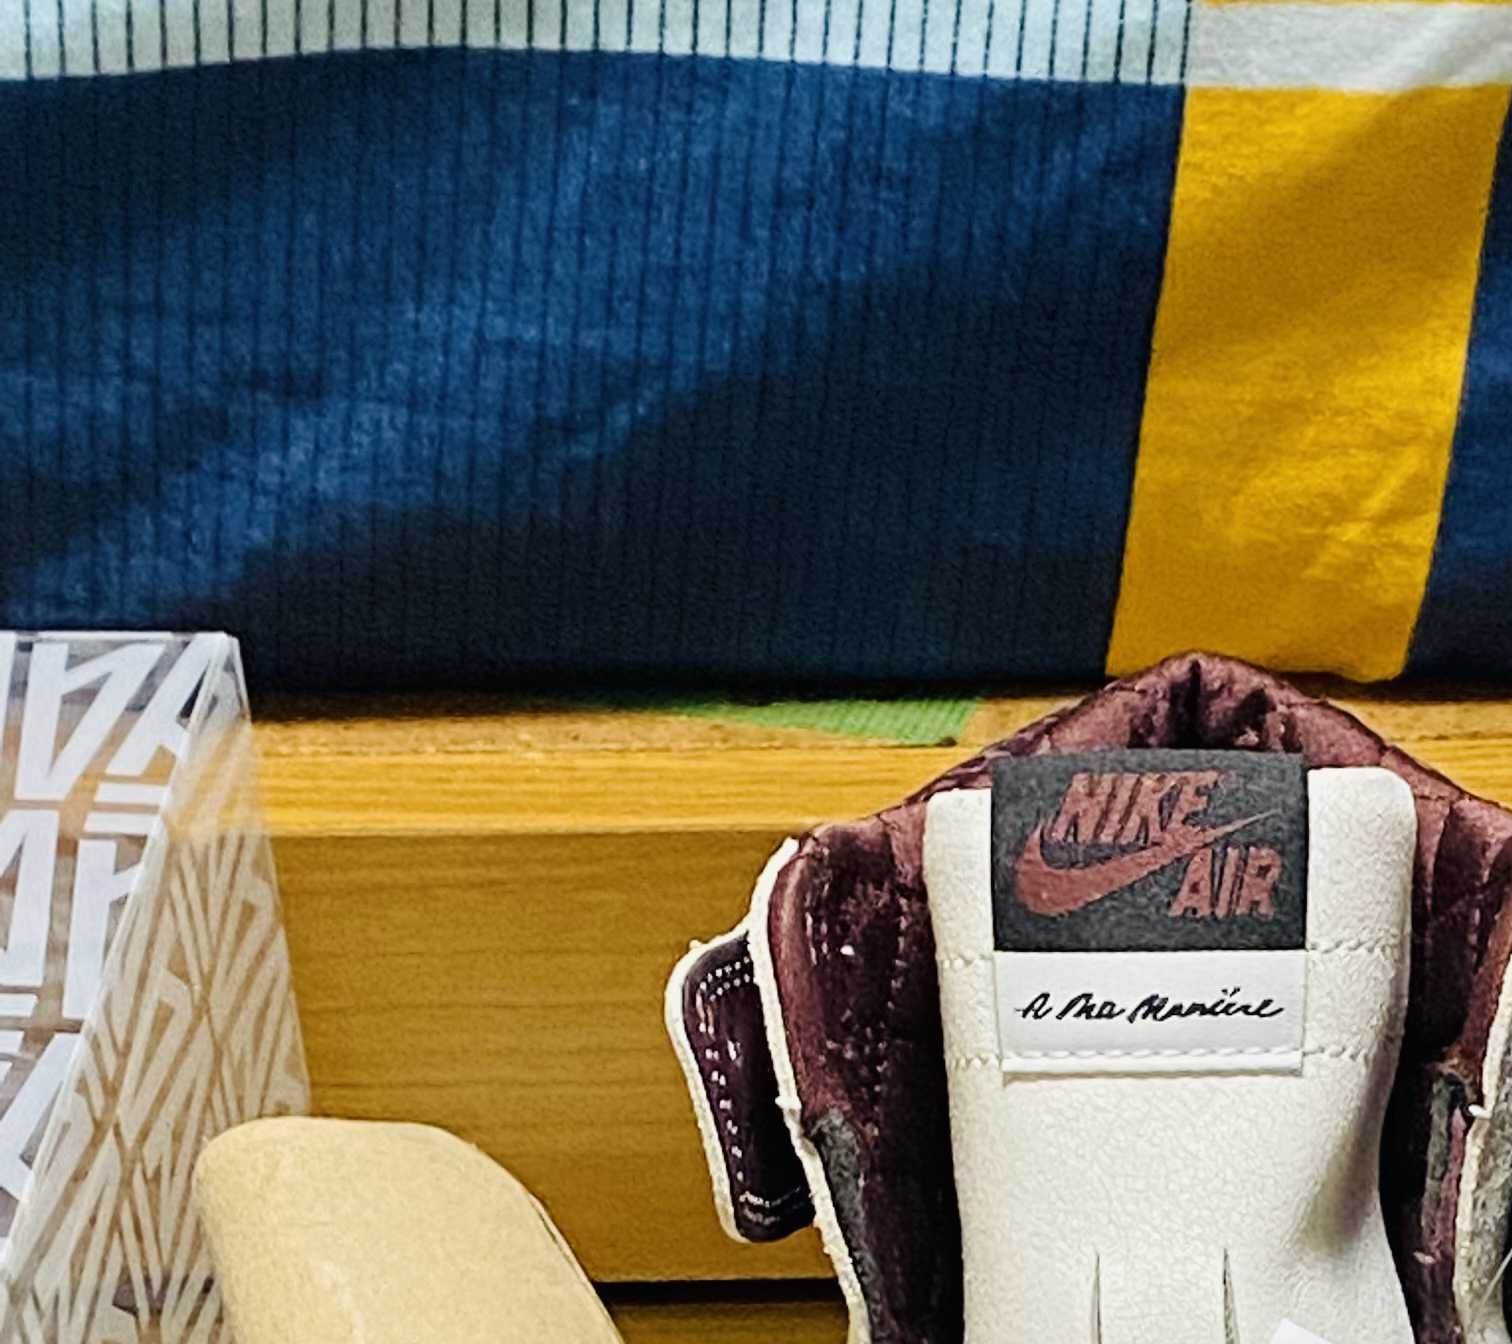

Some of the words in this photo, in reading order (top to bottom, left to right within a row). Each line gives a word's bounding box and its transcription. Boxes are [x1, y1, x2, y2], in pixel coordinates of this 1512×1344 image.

[1049, 771, 1219, 844] NIKE
[1169, 846, 1280, 919] AIR
[1055, 993, 1125, 1021] Ma
